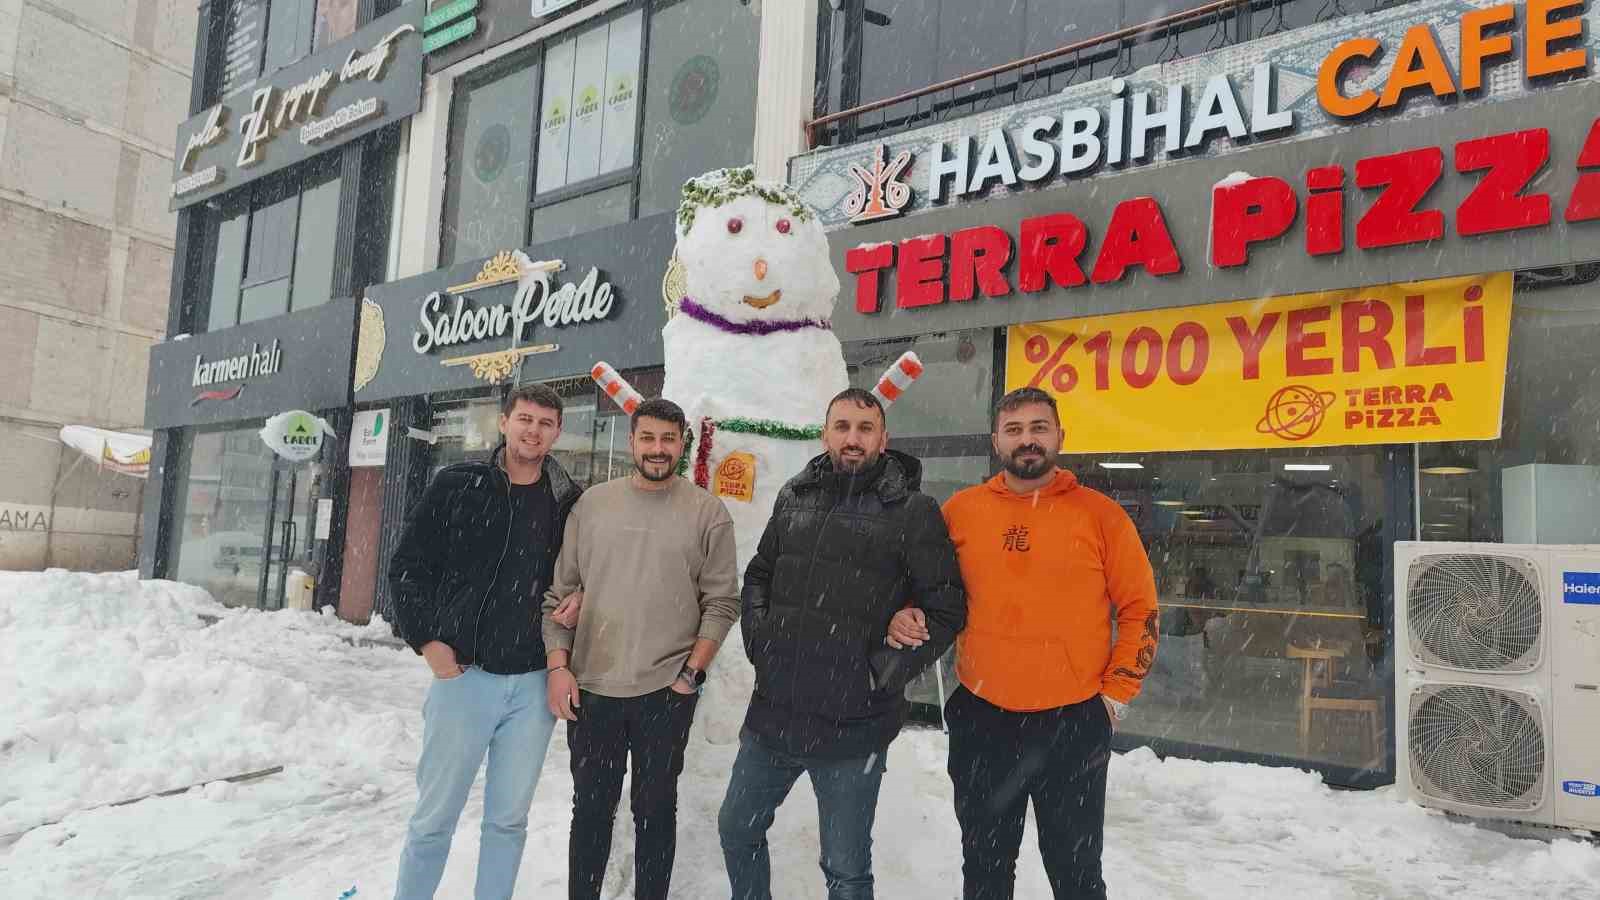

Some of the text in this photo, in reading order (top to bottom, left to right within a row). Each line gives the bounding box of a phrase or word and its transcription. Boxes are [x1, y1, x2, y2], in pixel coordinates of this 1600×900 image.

[928, 0, 1587, 202] HASBİHAL CAFE
[845, 196, 1181, 314] TERRA
[413, 266, 614, 354] Saloon Perde
[192, 354, 249, 387] karmen
[1024, 320, 1210, 393] %100
[1344, 382, 1454, 407] TERRA
[1001, 525, 1031, 554] 龍
